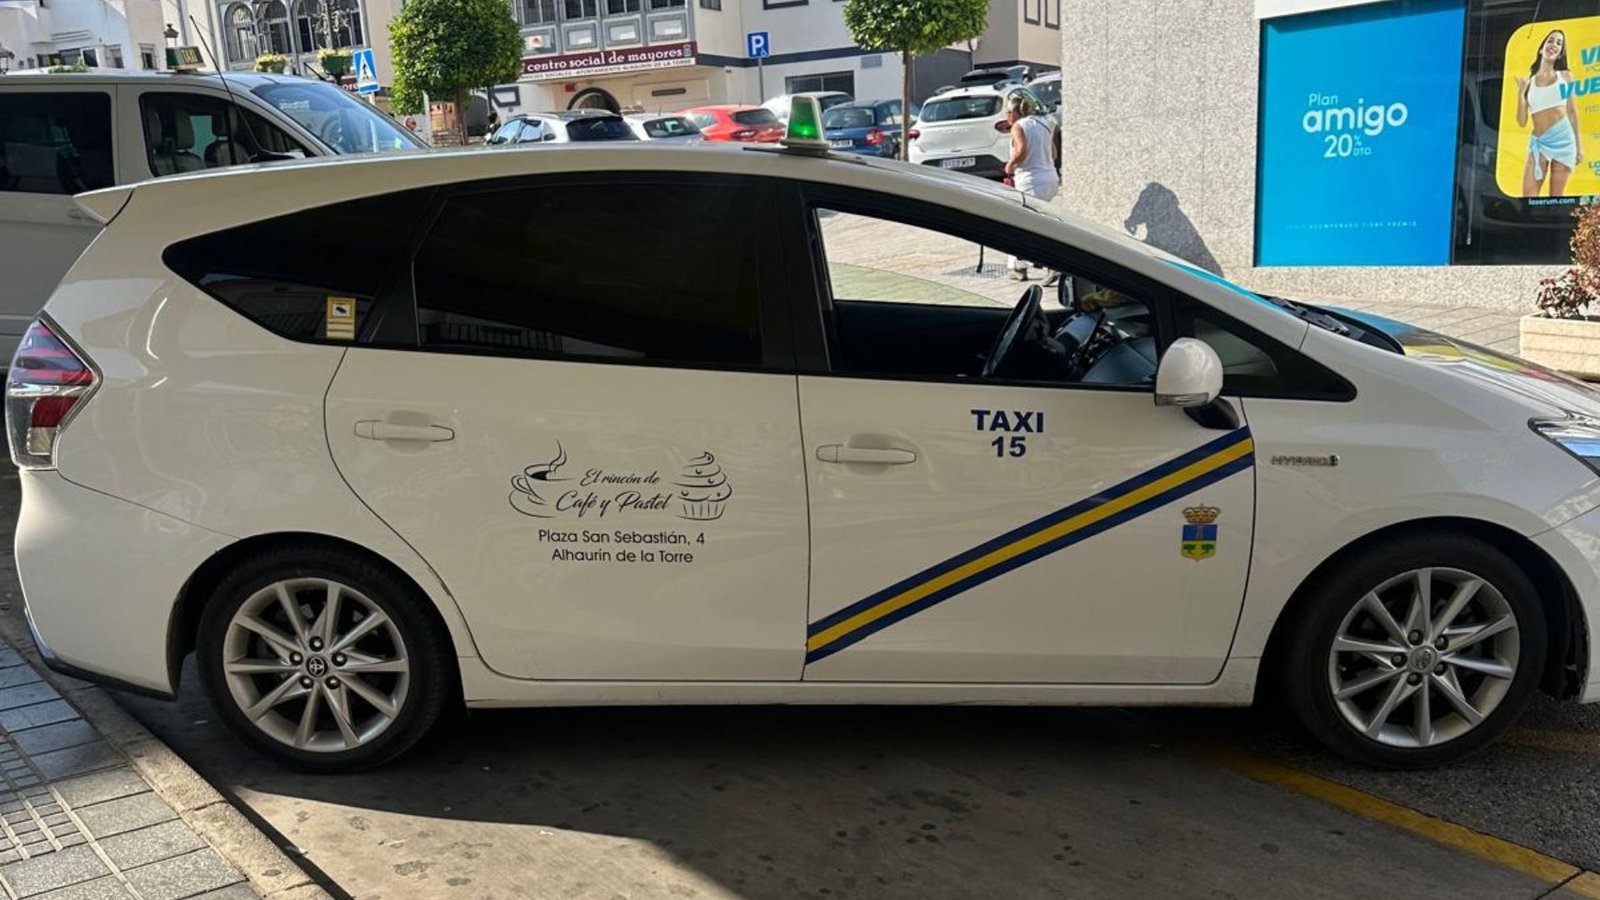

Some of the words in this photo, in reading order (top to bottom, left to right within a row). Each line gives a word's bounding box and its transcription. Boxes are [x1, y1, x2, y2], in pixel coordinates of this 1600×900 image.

[751, 35, 764, 55] P
[527, 60, 567, 72] centro
[569, 52, 606, 67] social
[608, 51, 625, 64] de
[627, 48, 683, 61] mayores
[1309, 91, 1339, 106] Plan
[1302, 98, 1408, 136] amigo
[971, 409, 1043, 433] TAXI
[992, 436, 1026, 458] 15
[580, 468, 602, 487] El
[601, 473, 640, 484] rincón
[643, 470, 660, 484] de
[556, 490, 598, 518] Café
[599, 499, 611, 518] y
[615, 490, 673, 513] Pastel
[538, 529, 578, 543] Plaza
[582, 530, 610, 543] San
[614, 530, 691, 546] Sebastián,
[696, 532, 705, 544] 4
[552, 548, 611, 562] Alhaurín
[616, 549, 636, 562] de
[640, 549, 655, 562] la
[659, 550, 694, 563] Torre
